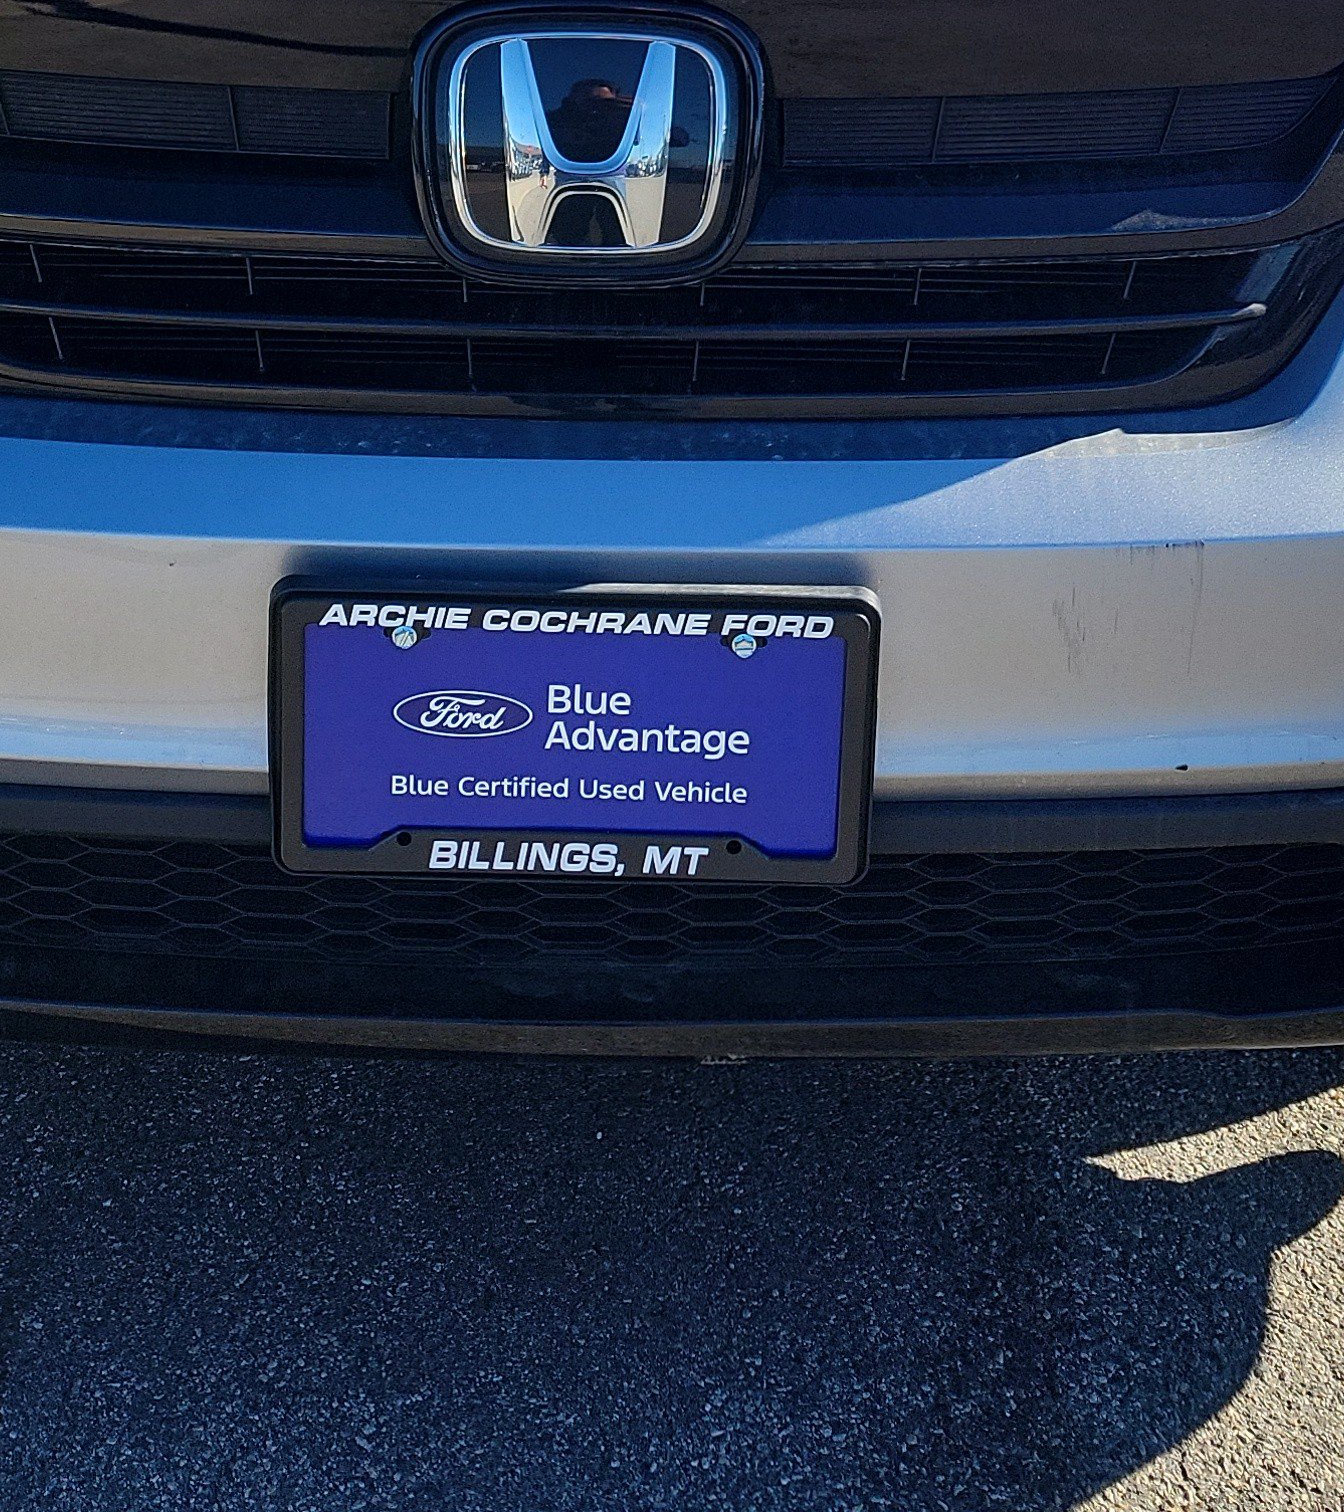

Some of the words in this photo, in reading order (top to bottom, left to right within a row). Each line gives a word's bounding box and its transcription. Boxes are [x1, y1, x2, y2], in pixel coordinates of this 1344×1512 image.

[319, 603, 469, 630] ARCHIE
[481, 609, 710, 637] COCHRANE
[721, 614, 835, 640] FORD
[420, 695, 507, 733] Ford
[546, 684, 632, 716] Blue
[544, 721, 751, 761] Advantage
[390, 774, 449, 797] Blue
[457, 775, 570, 800] Certified
[578, 778, 646, 802] Used
[654, 780, 749, 805] Vehicle
[427, 840, 627, 878] BILLINGS,
[641, 845, 709, 877] MT
